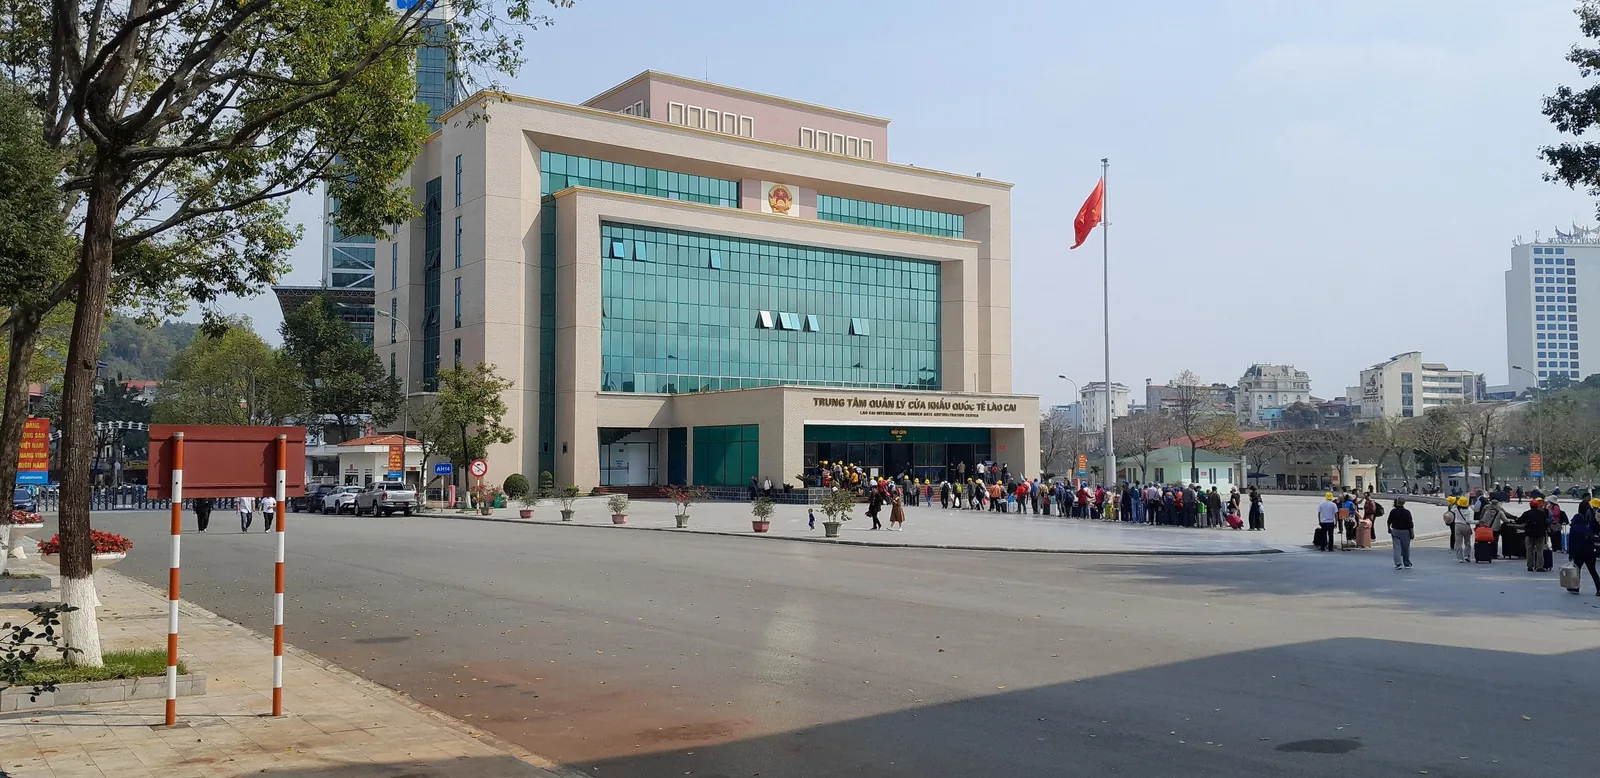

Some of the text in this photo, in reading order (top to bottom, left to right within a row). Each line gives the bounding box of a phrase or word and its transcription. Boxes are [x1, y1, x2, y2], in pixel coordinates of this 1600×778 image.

[813, 397, 845, 407] TRUNG
[847, 396, 867, 408] TÂM
[869, 397, 894, 408] QUẢN
[896, 398, 906, 409] LÝ
[952, 400, 975, 411] QUỐC
[987, 402, 1003, 412] LÀO
[1003, 403, 1016, 412] CAI
[34, 431, 46, 439] SẢN
